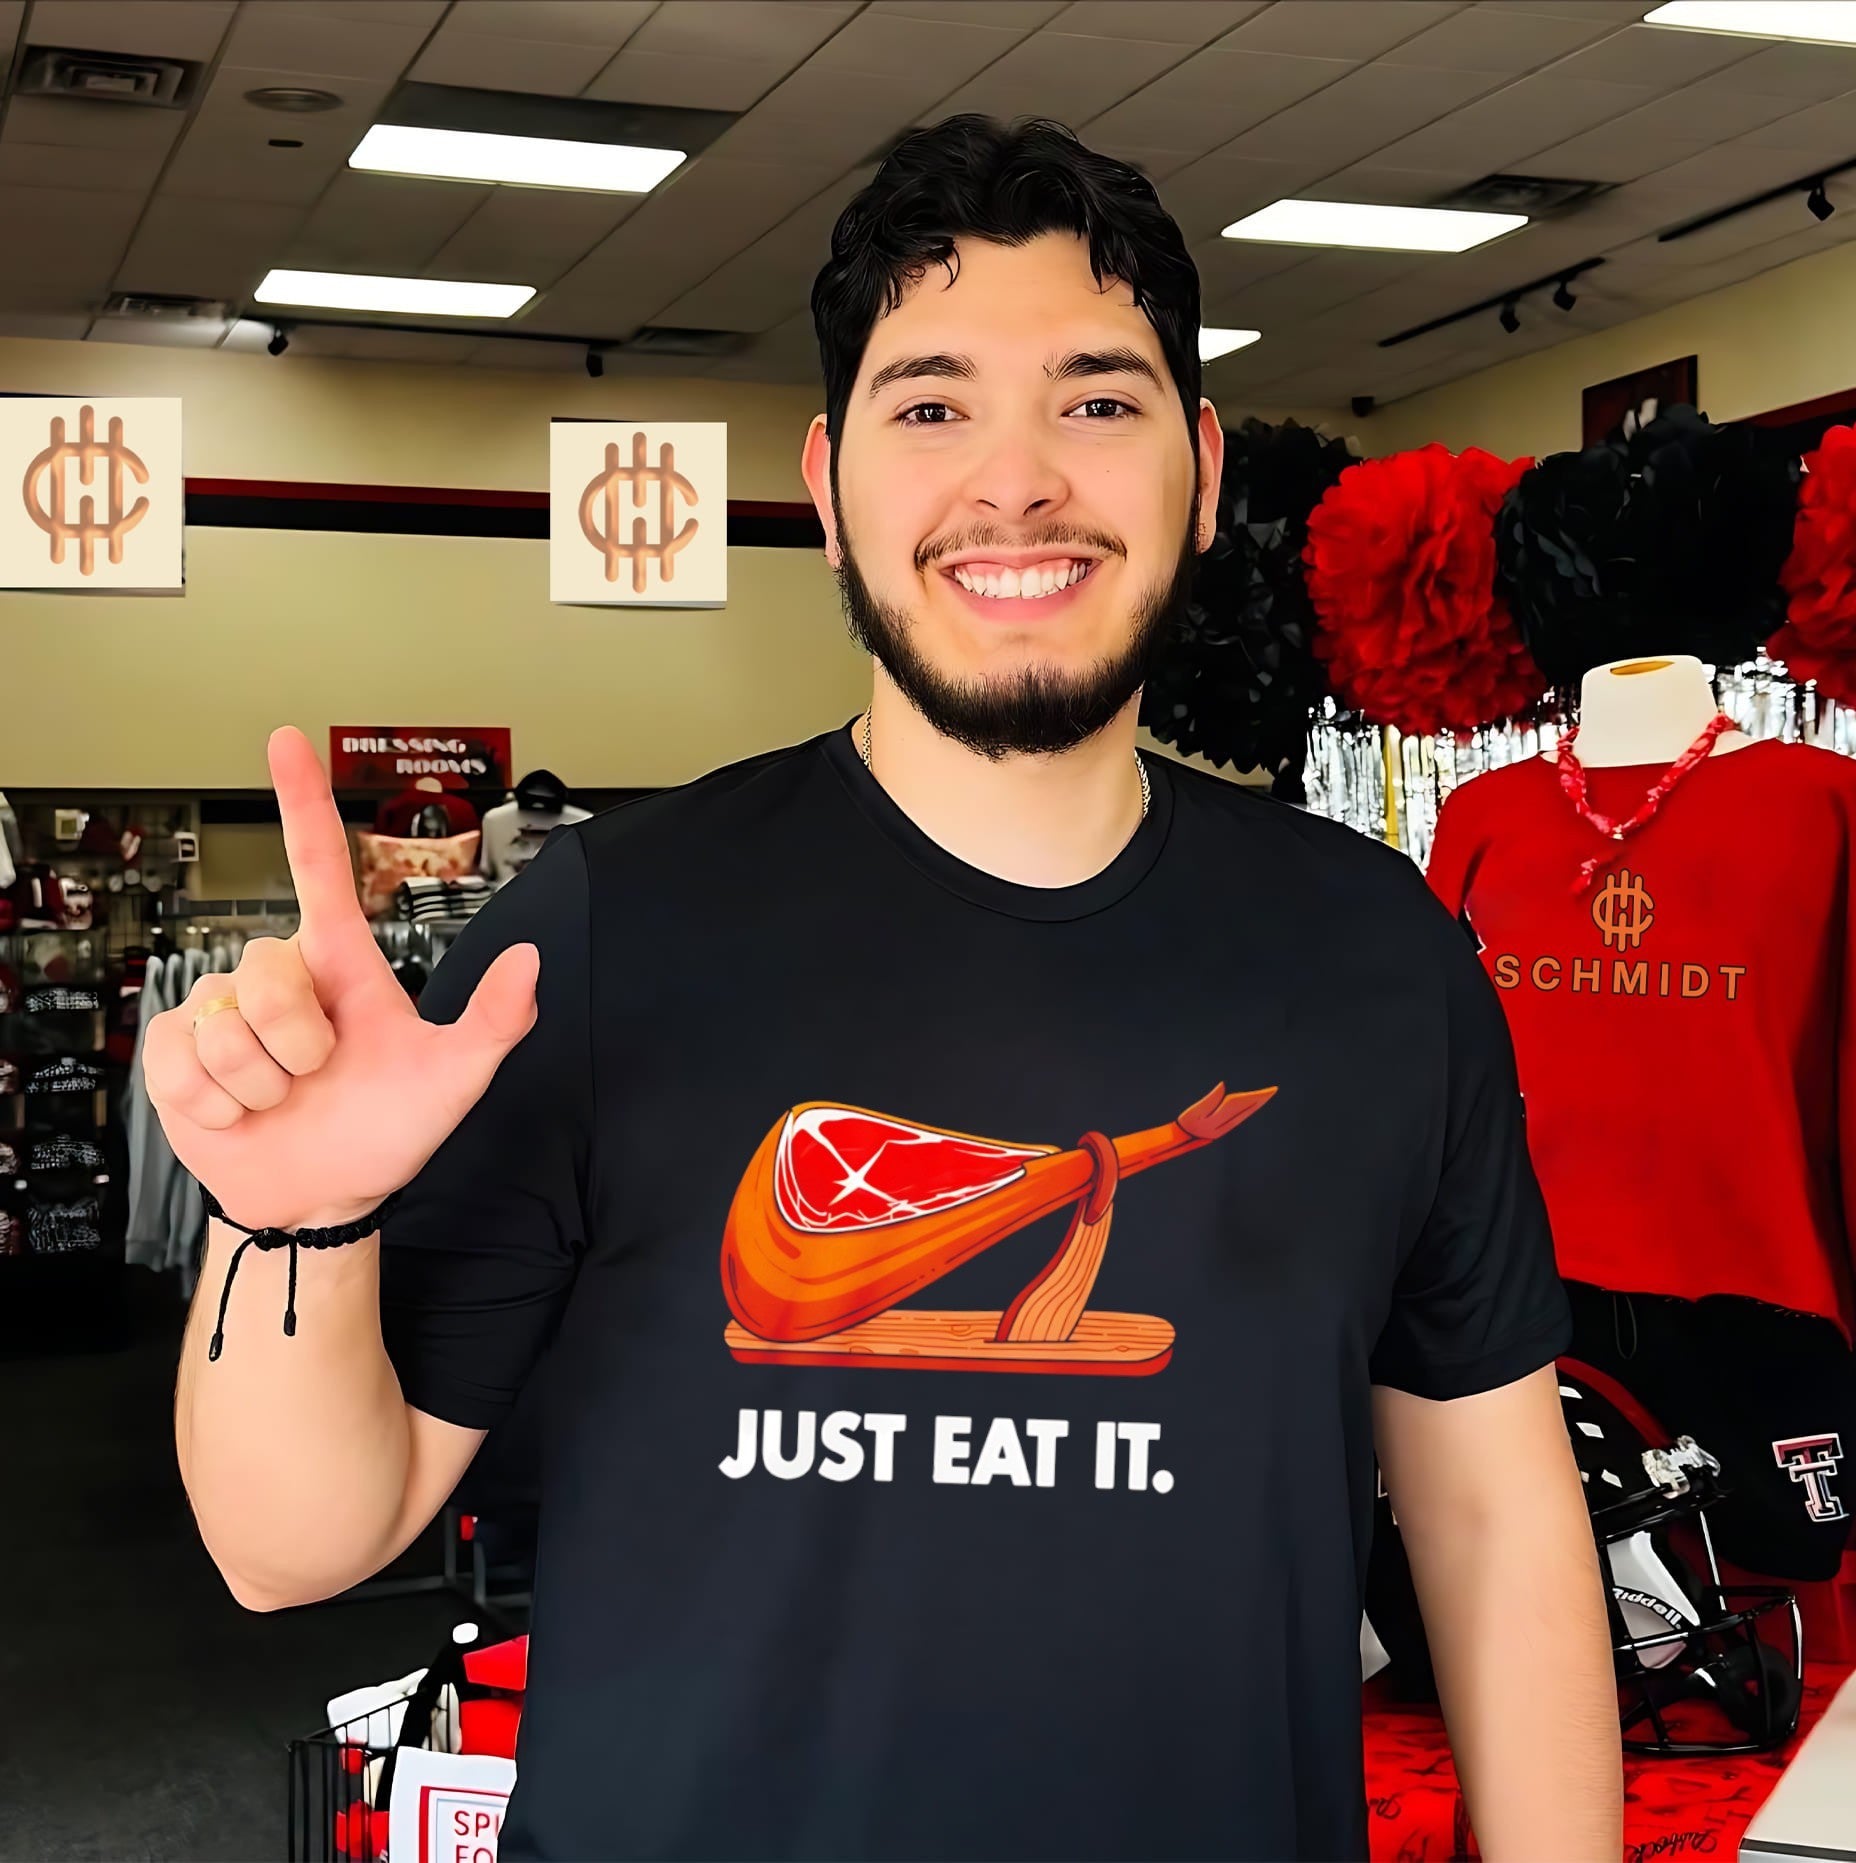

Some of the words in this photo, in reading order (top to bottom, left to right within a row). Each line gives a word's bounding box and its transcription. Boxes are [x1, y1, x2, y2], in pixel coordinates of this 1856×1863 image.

[342, 737, 467, 754] DRESSING
[396, 758, 487, 775] ROOMS
[1494, 954, 1747, 1000] SCHMIDT
[718, 1408, 907, 1482] JUST
[933, 1415, 1069, 1487] EAT
[1095, 1421, 1174, 1494] IT.
